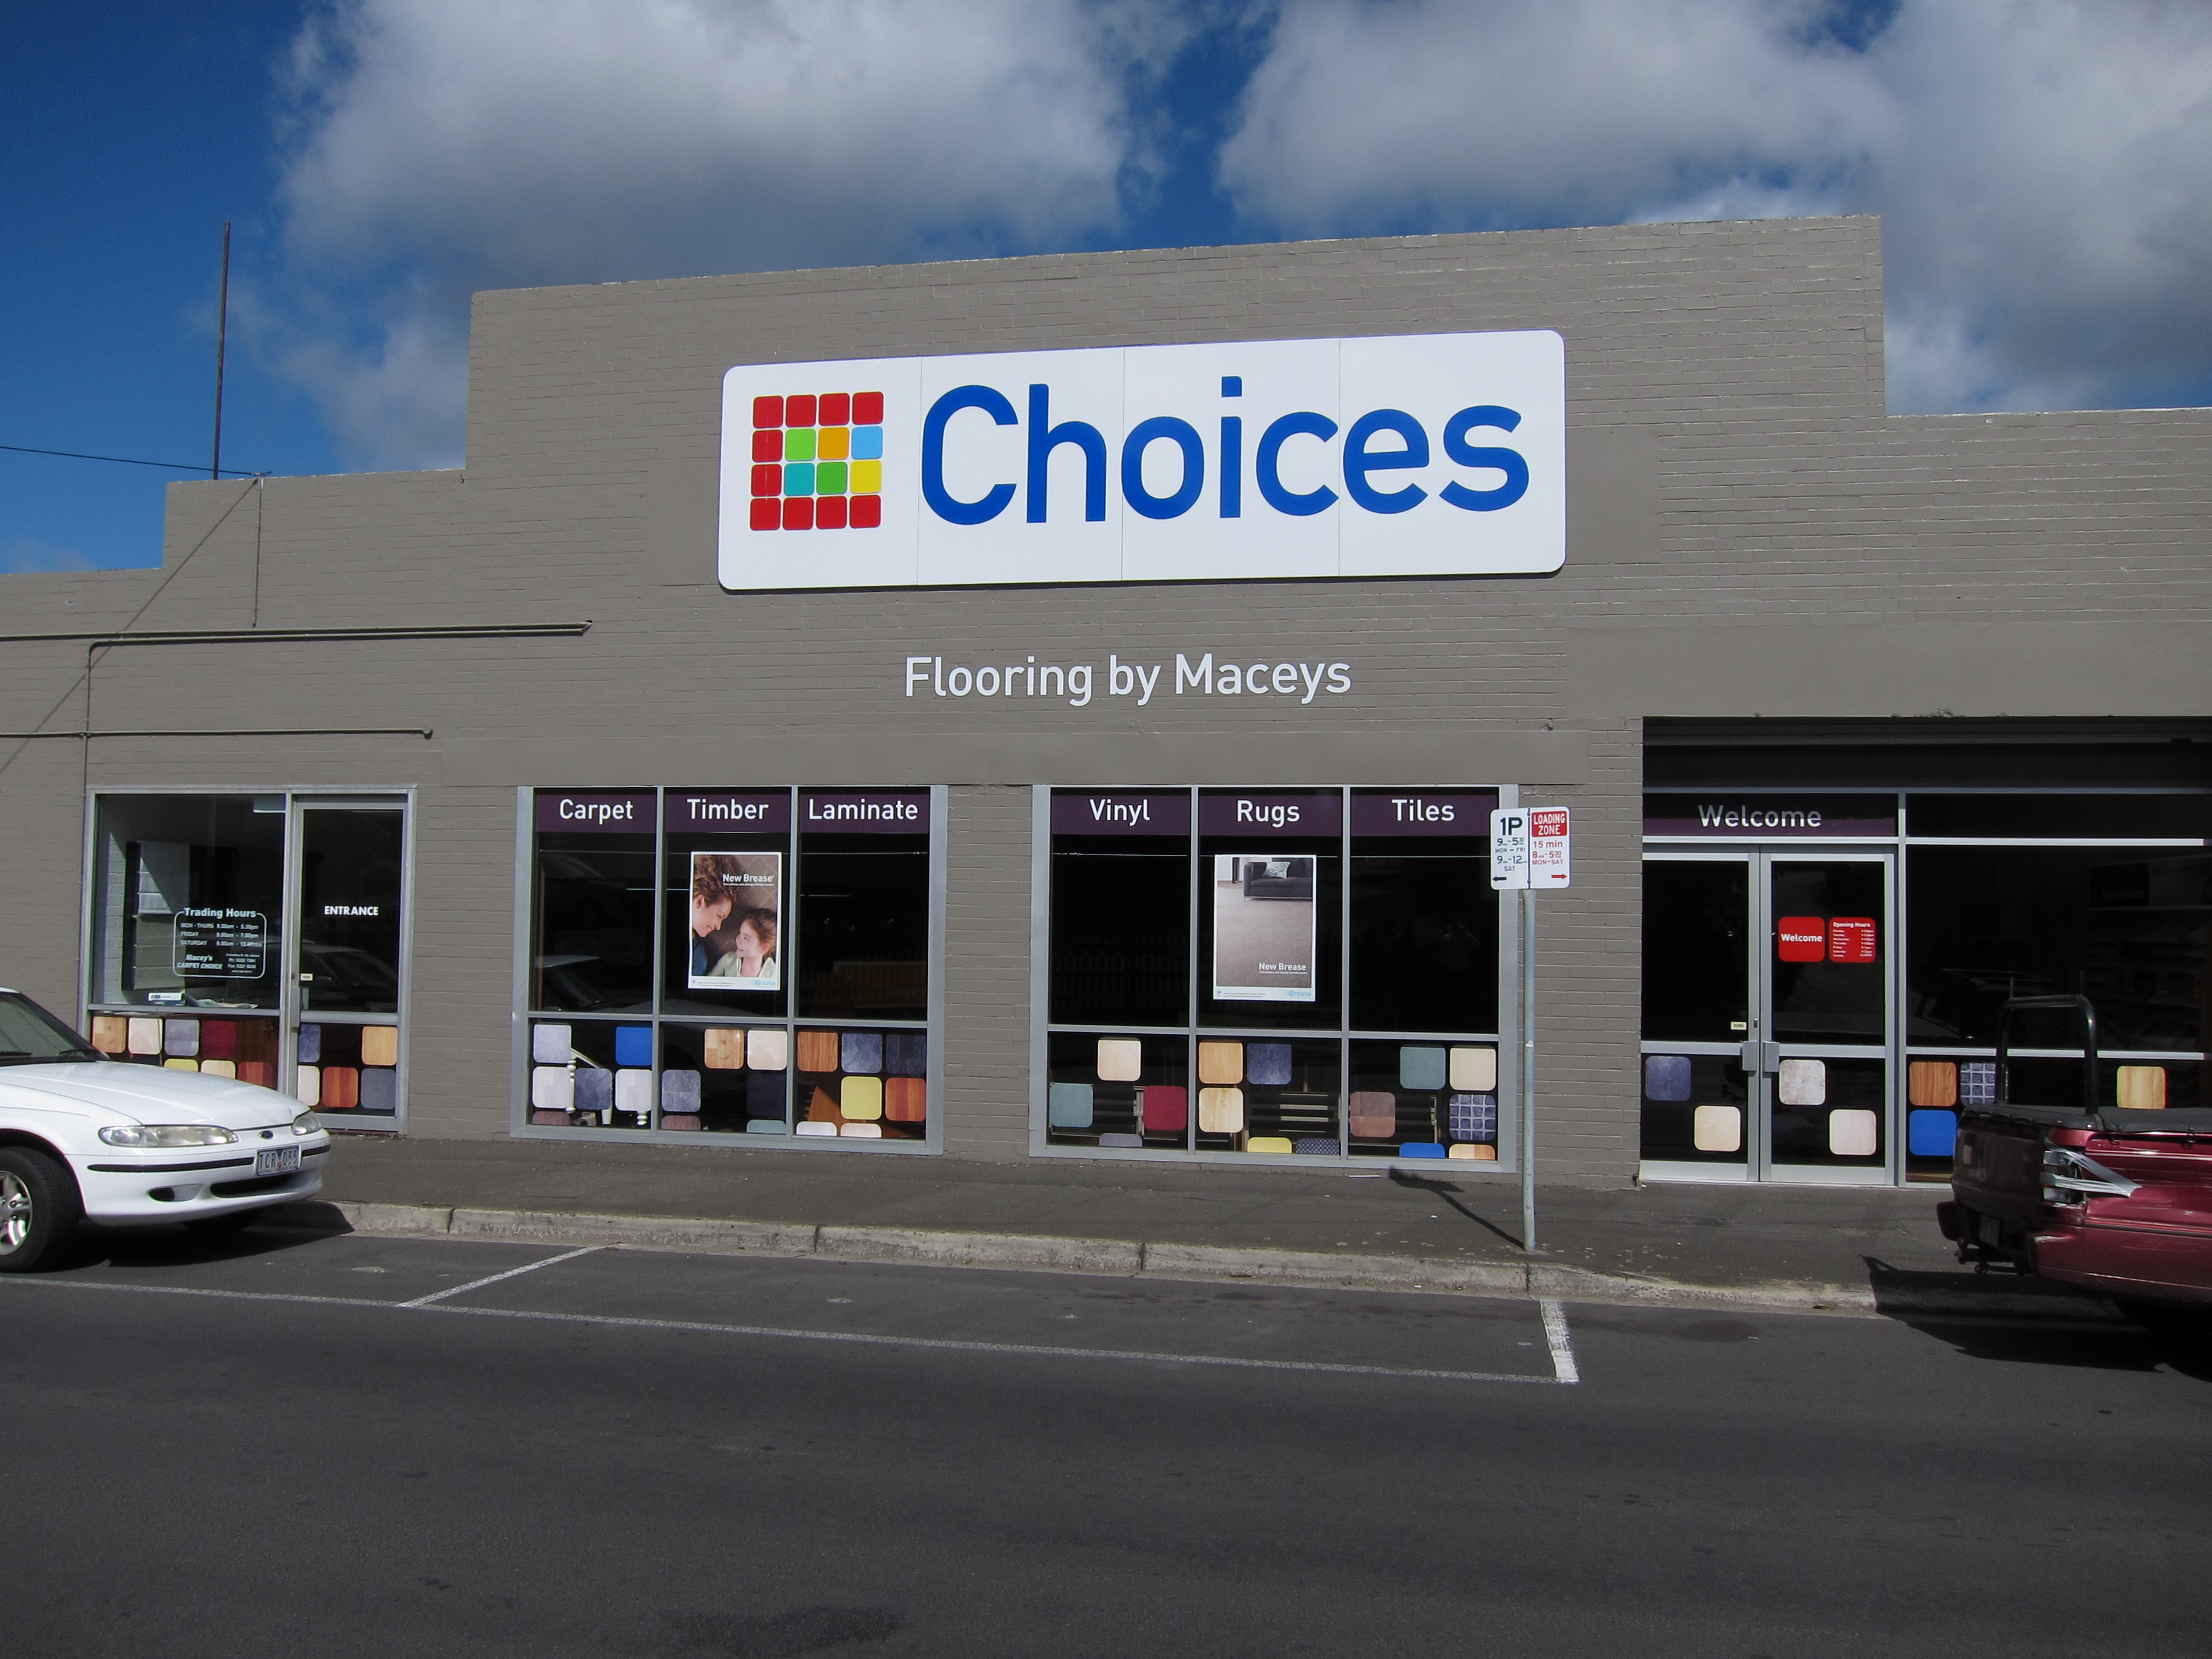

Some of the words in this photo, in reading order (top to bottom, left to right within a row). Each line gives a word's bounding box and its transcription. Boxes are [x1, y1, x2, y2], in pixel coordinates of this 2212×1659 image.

[922, 376, 1529, 526] Choices
[906, 655, 1092, 706] Flooring
[1110, 654, 1161, 706] by
[1176, 653, 1351, 704] Maceys
[559, 798, 634, 825] Carpet
[686, 798, 769, 820] Timber
[808, 798, 919, 820] Laminate
[1090, 799, 1150, 826] Vinyl
[1238, 800, 1299, 828] Rugs
[1391, 799, 1455, 822] Tiles
[1699, 805, 1822, 828] Welcome
[1500, 817, 1523, 836] 1P
[1533, 813, 1565, 825] LOADING
[1538, 825, 1561, 836] ZONE
[1546, 840, 1563, 848] min
[722, 873, 742, 882] New
[743, 873, 773, 882] Brease
[184, 907, 223, 919] Trading
[226, 908, 257, 918] Hours
[324, 905, 379, 916] ENTRANCE
[1780, 933, 1823, 942] Welcome
[185, 954, 213, 962] Macey's
[1278, 962, 1307, 971] Brease
[259, 1152, 276, 1170] TCR
